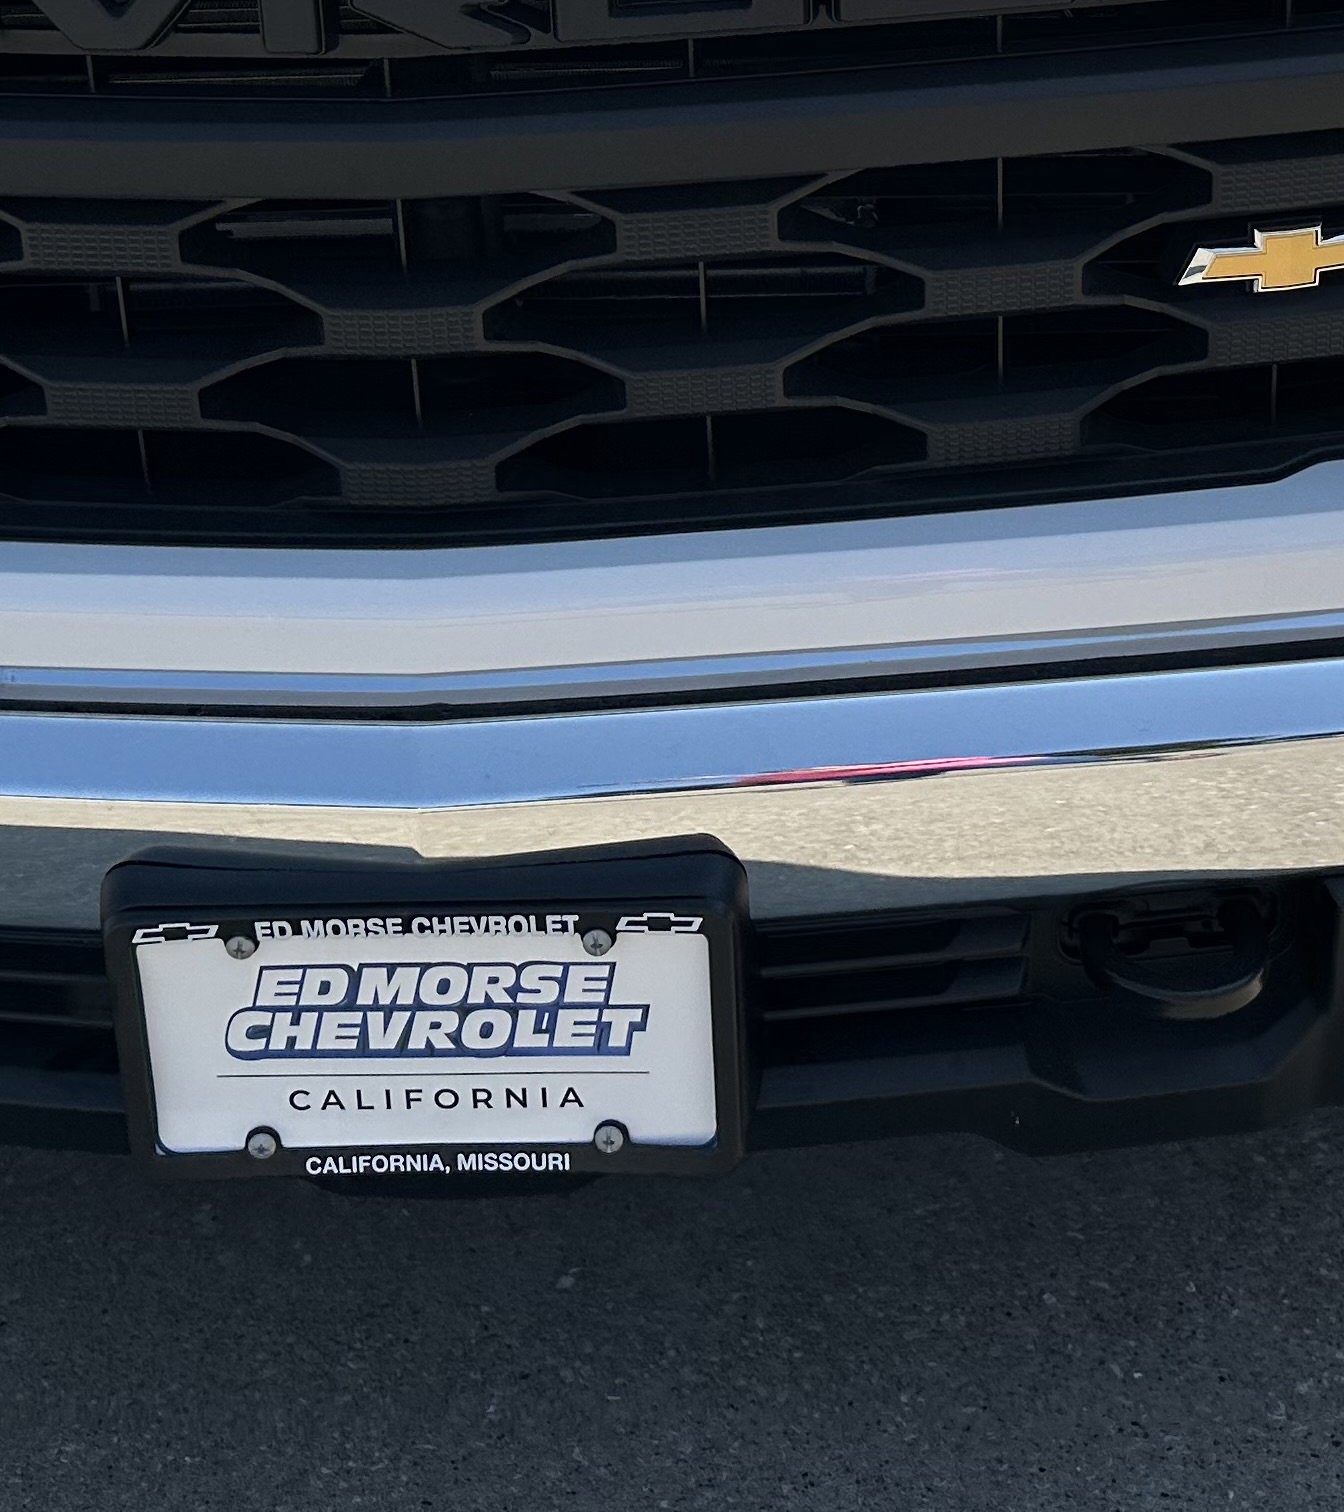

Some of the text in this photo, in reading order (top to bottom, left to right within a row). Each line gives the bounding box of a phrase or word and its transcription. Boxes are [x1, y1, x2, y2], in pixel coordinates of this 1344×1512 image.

[255, 914, 579, 940] ED MORSE CHEVROLET
[252, 961, 616, 1008] ED MORSE
[224, 1004, 650, 1059] CHEVROLET
[288, 1086, 585, 1112] CALIFORNIA
[304, 1152, 572, 1176] CALIFORNIA, MISSOURI
